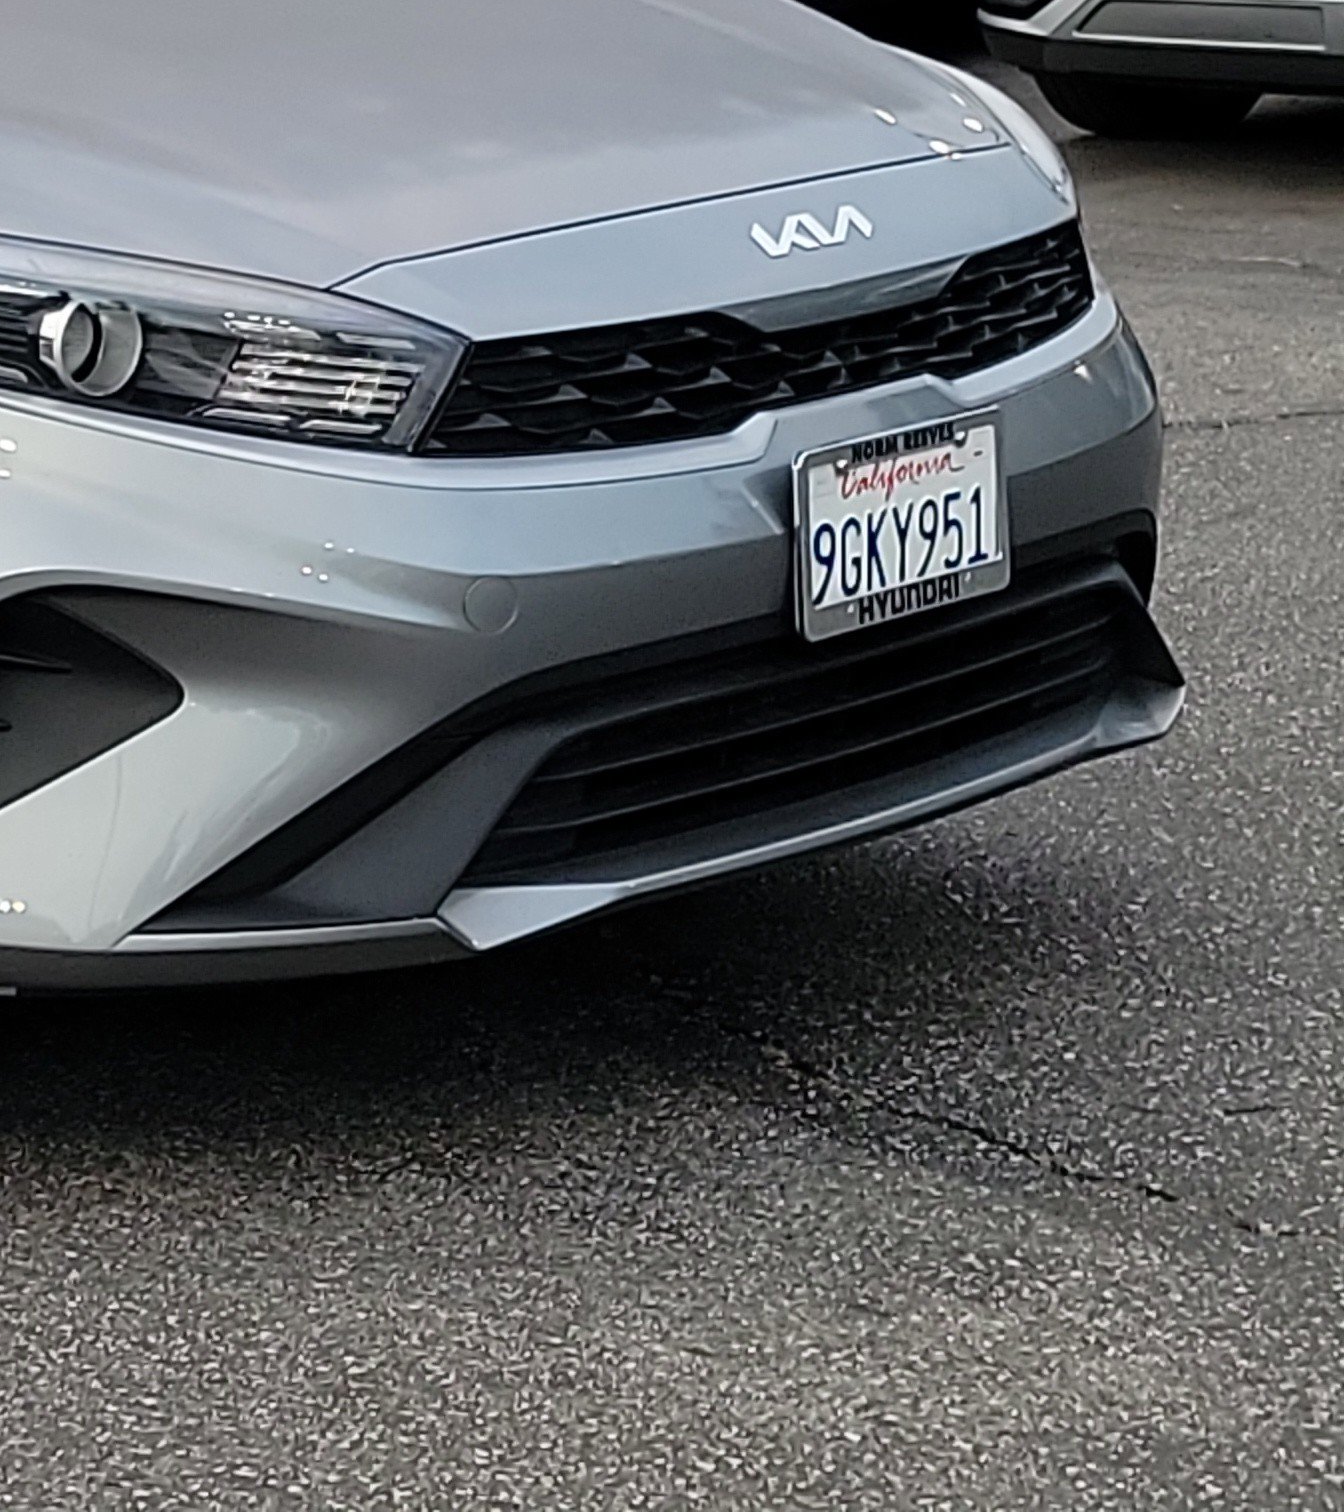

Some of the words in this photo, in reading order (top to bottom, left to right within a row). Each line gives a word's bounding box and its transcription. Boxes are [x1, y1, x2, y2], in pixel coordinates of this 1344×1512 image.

[850, 436, 899, 463] NORM
[841, 452, 965, 503] California
[812, 485, 989, 606] 9GKY951
[858, 572, 961, 625] HYUNDAI
